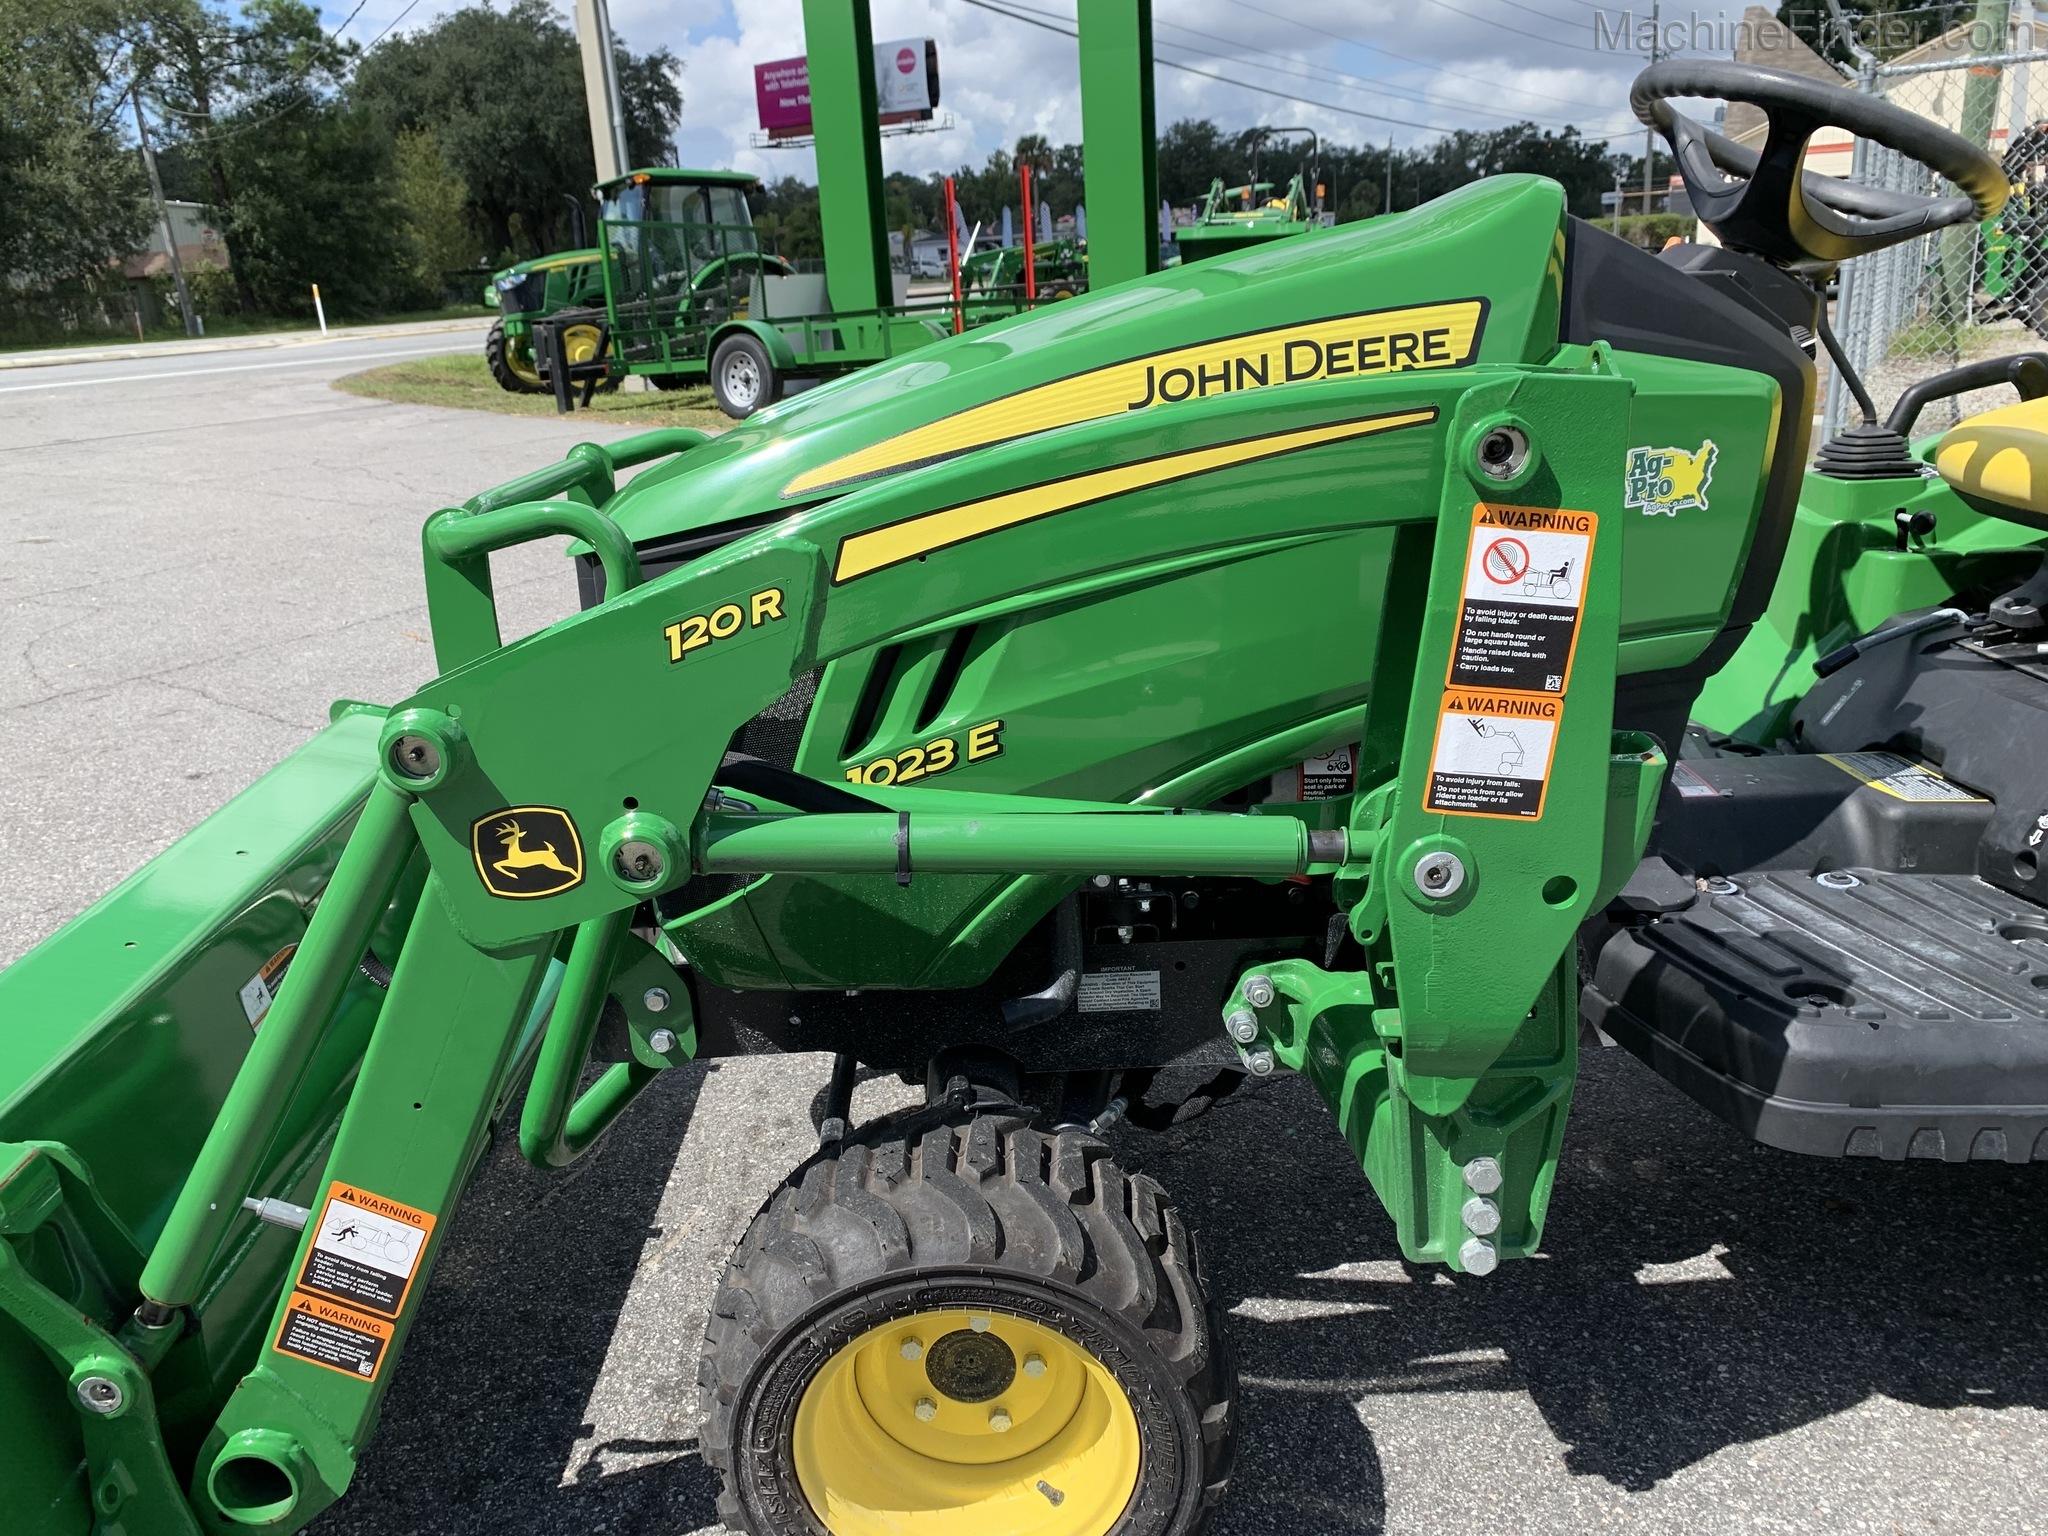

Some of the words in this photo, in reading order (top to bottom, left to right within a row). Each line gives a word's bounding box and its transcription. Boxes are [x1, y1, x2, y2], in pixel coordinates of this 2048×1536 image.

[764, 67, 796, 80] Anywhere
[1128, 353, 1268, 409] JOHN
[1284, 328, 1451, 382] DEERE
[1628, 451, 1673, 479] Ag-
[1629, 476, 1673, 502] Pro
[1646, 498, 1695, 512] AgProCo.com
[1499, 510, 1589, 532] WARNING
[664, 604, 746, 663] 120
[751, 587, 787, 628] R
[1475, 616, 1496, 624] falling
[1497, 610, 1517, 618] injury
[1528, 612, 1547, 620] death
[1465, 636, 1482, 645] large
[1460, 663, 1479, 671] Carry
[1468, 697, 1556, 717] WARNING
[968, 720, 1004, 763] E
[1466, 778, 1485, 786] injury
[1435, 799, 1478, 808] attachments.
[360, 1194, 422, 1224] WARNING
[315, 1257, 334, 1267] loader:
[340, 1260, 356, 1269] injury
[370, 1271, 387, 1280] falling
[312, 1280, 332, 1289] parked.
[314, 1274, 330, 1282] Lower
[332, 1280, 349, 1289] loader
[356, 1290, 376, 1298] ground
[316, 1270, 336, 1278] service
[358, 1284, 375, 1292] raised
[376, 1290, 393, 1299] loader.
[357, 1278, 378, 1288] perform
[320, 1305, 381, 1334] WARNING
[292, 1327, 310, 1336] Failure
[317, 1335, 335, 1344] engage
[336, 1341, 356, 1350] retainer
[295, 1320, 319, 1331] engaging
[319, 1326, 348, 1340] attachment
[319, 1322, 338, 1331] operate
[339, 1328, 356, 1336] loader
[356, 1334, 375, 1343] without
[287, 1341, 303, 1350] bodily
[303, 1347, 317, 1355] injury
[290, 1332, 305, 1340] result
[311, 1338, 340, 1351] attachment
[341, 1349, 366, 1360] detaching
[301, 1340, 318, 1349] loader
[319, 1346, 338, 1356] causing
[339, 1354, 358, 1362] serious
